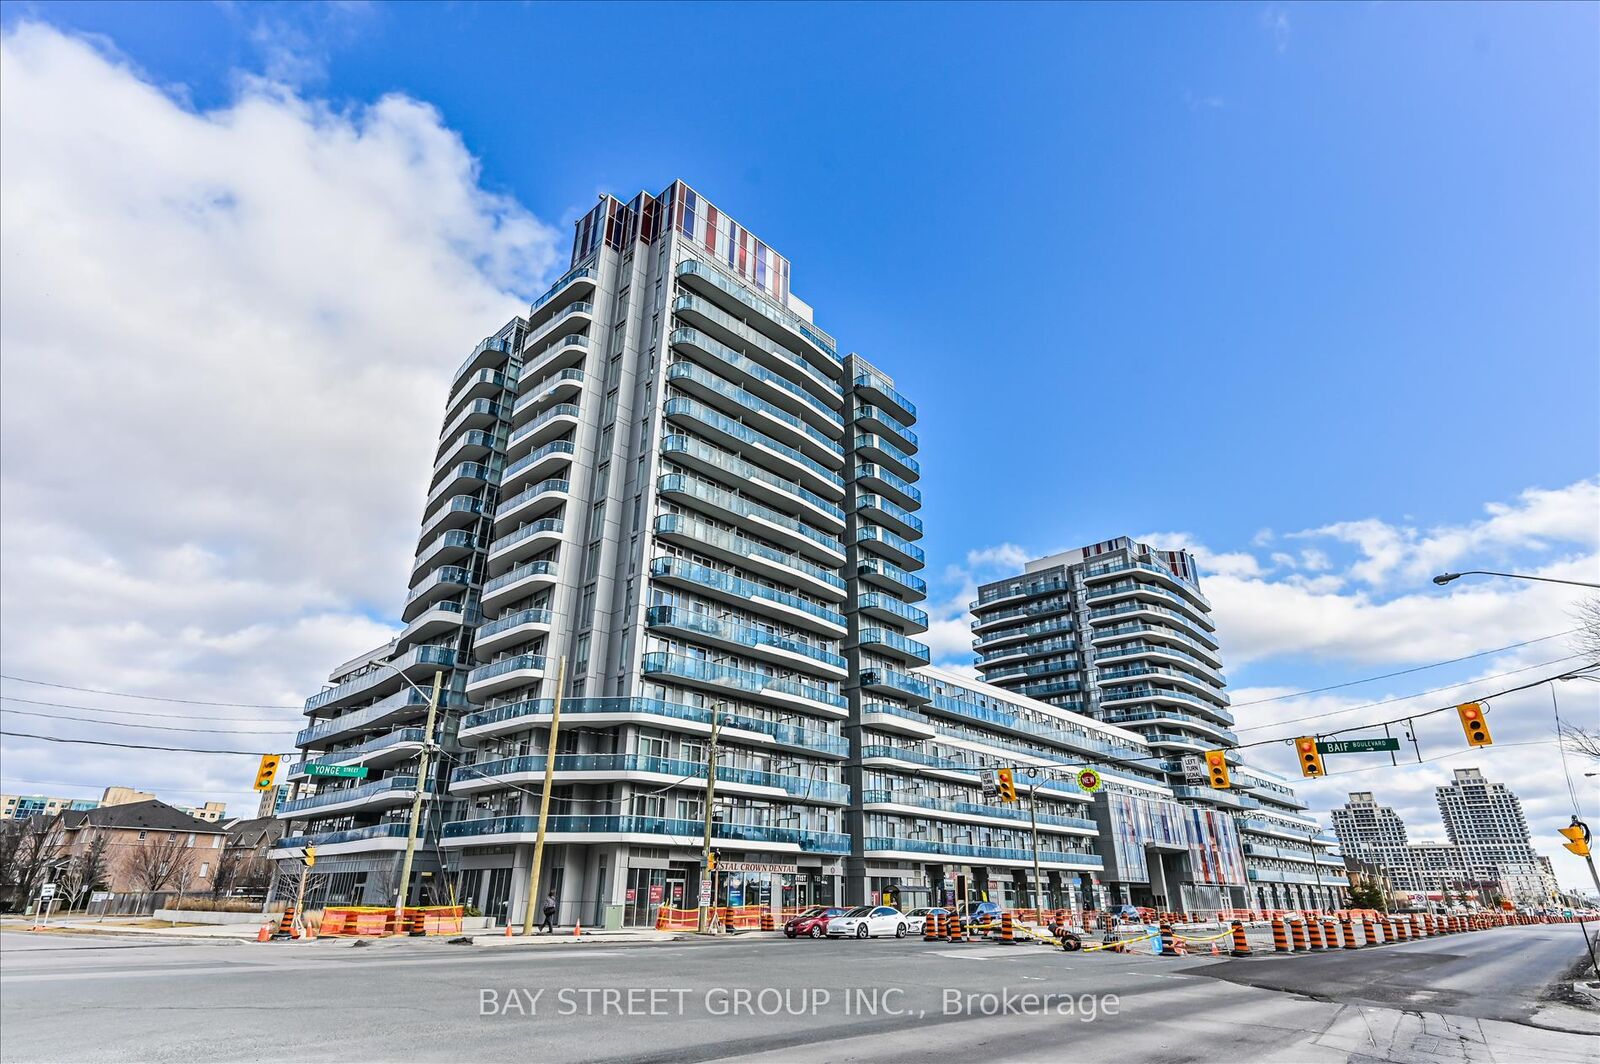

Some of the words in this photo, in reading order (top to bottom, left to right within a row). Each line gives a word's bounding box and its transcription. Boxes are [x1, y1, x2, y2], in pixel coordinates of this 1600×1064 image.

[1327, 743, 1349, 752] BAIF
[1352, 740, 1387, 748] BOULEVARD
[315, 765, 341, 775] YONGE
[1081, 776, 1095, 785] NEW
[740, 863, 768, 872] CROWN
[768, 864, 796, 873] DENTAL
